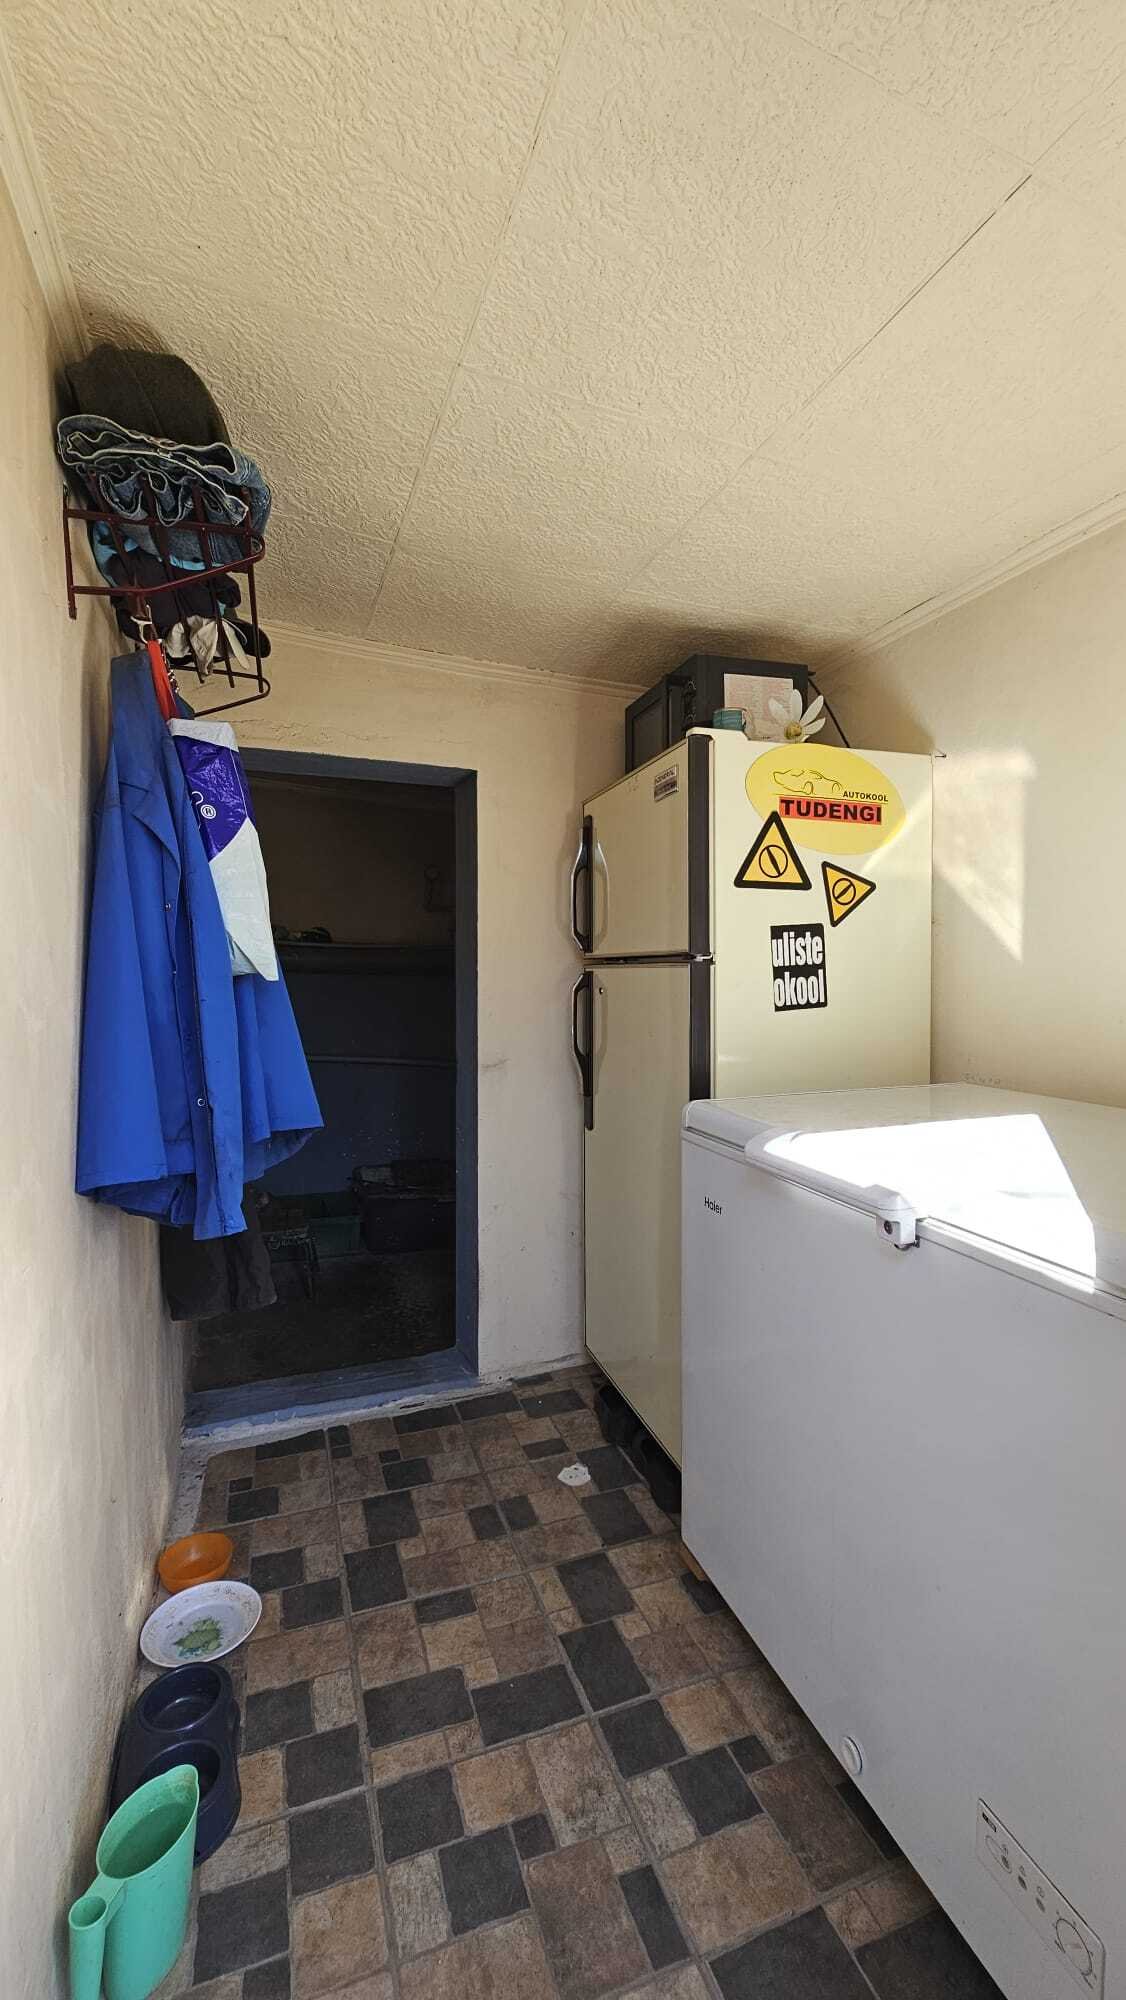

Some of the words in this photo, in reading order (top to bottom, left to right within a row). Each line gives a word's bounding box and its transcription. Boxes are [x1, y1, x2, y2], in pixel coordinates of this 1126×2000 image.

[843, 791, 888, 802] AUTOKOOL
[780, 799, 882, 822] TUDENGI
[772, 931, 823, 967] uliste
[774, 969, 825, 1007] okool
[704, 1196, 722, 1215] Haier
